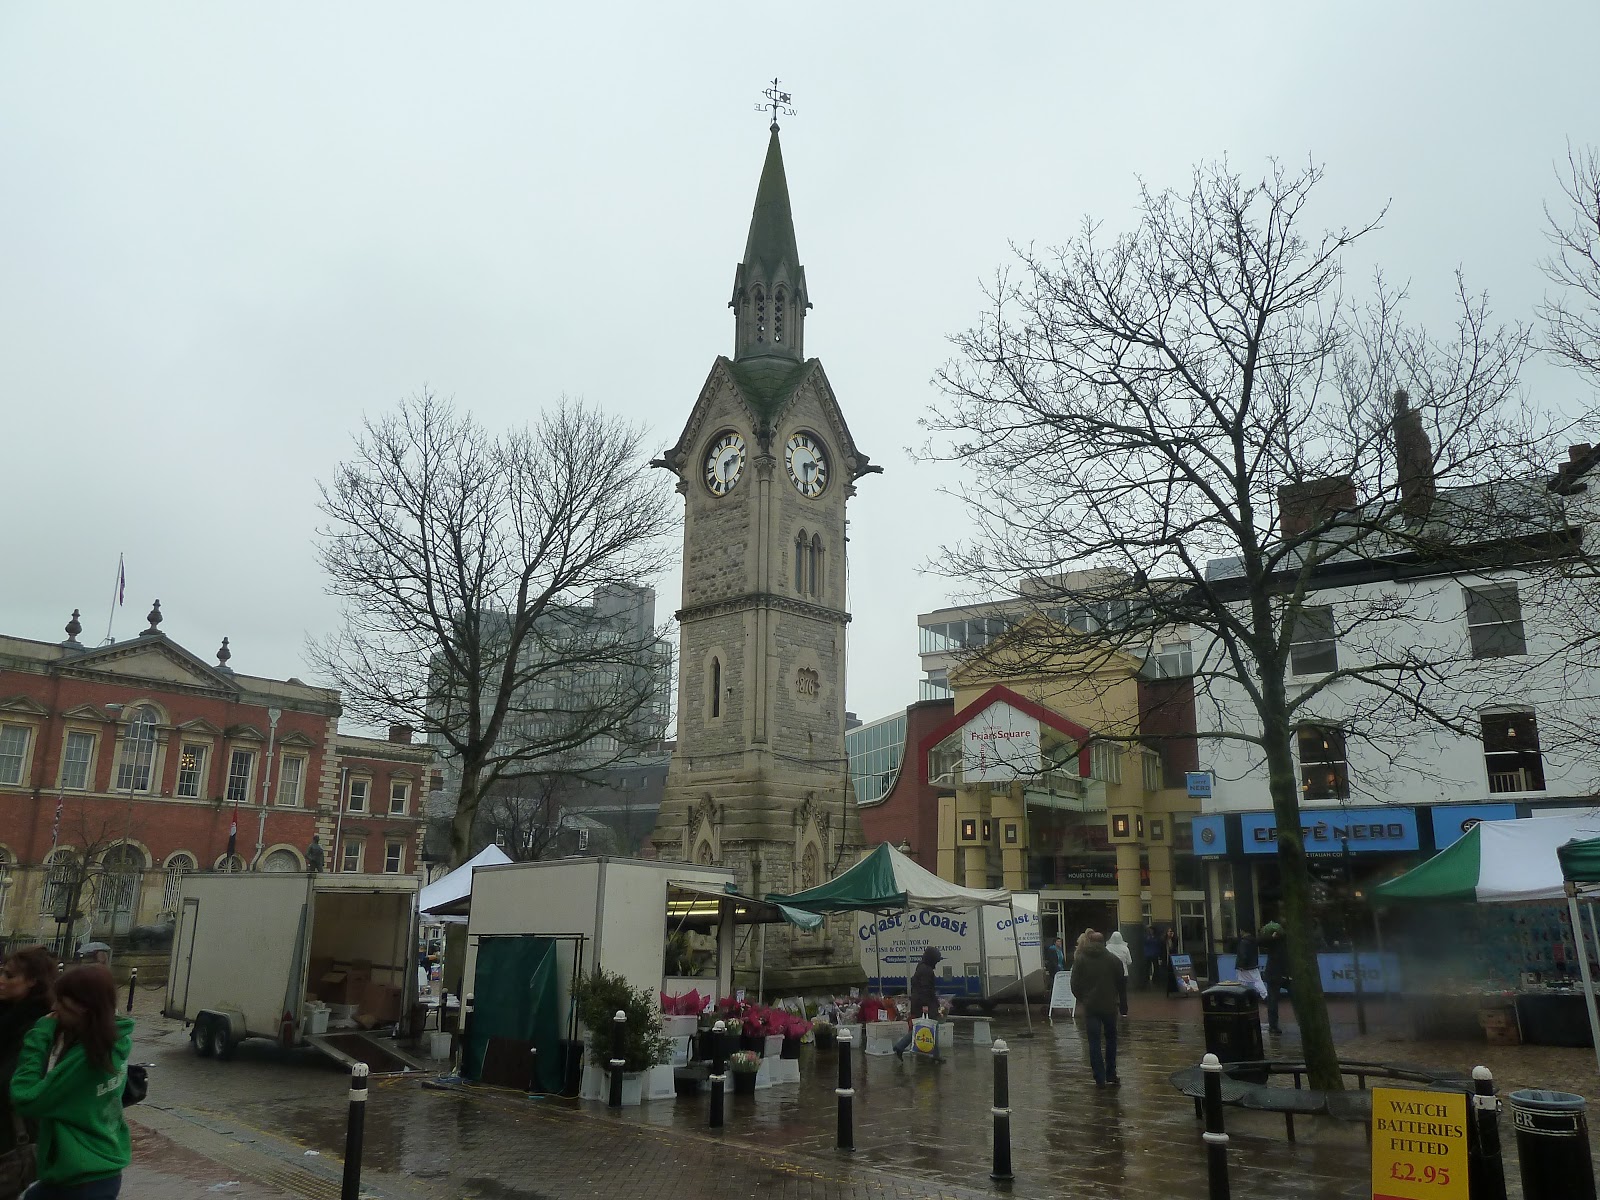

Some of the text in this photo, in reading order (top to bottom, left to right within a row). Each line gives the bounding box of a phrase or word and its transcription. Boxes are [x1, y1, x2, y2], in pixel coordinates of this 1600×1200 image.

[1253, 820, 1404, 842] CAFÈ NERO
[859, 913, 903, 940] Coast
[919, 909, 968, 937] Coast
[1389, 1100, 1448, 1118] WATCH
[1376, 1118, 1464, 1139] BATTERIES
[1390, 1137, 1449, 1156] FITTED
[1389, 1161, 1450, 1186] £2.95
